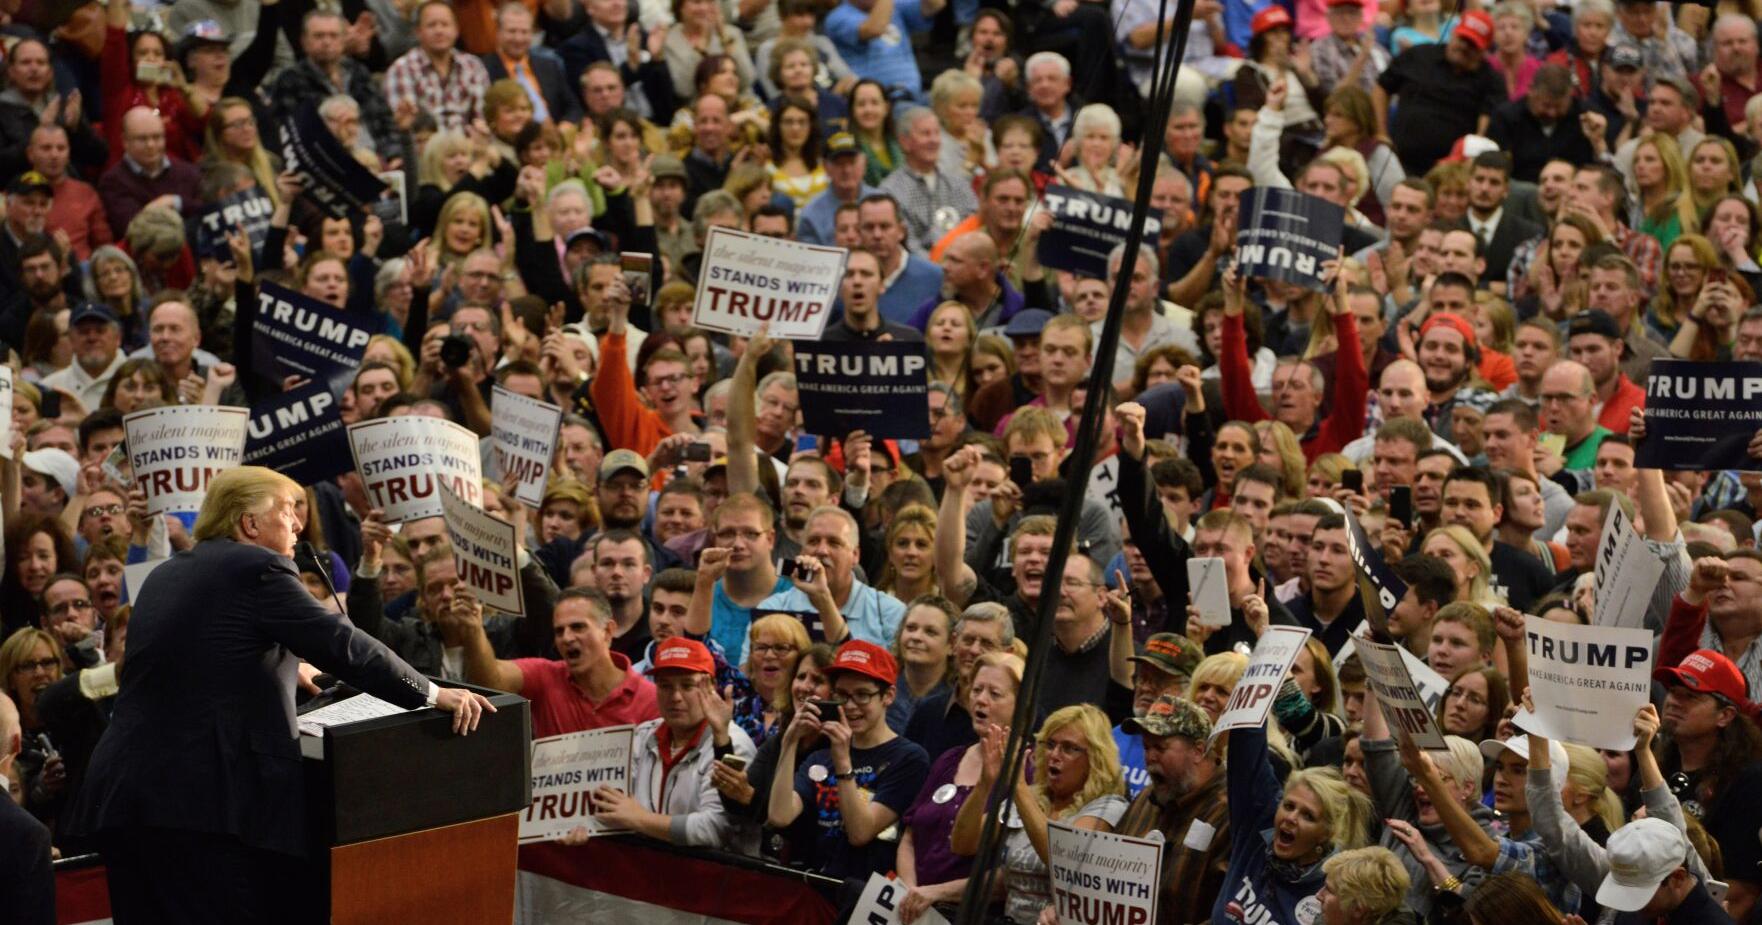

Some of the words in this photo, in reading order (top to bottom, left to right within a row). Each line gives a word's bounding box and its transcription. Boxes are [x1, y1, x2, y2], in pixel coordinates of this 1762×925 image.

[1045, 193, 1161, 236] TRUMP
[710, 266, 781, 291] STANDS
[787, 279, 830, 295] WITH
[707, 286, 822, 323] TRUMP
[258, 291, 370, 349] TRUMP
[270, 327, 303, 348] AMERICA
[303, 341, 332, 358] GREAT
[795, 352, 925, 377] TRUMP
[820, 383, 858, 394] AMERICA
[860, 385, 889, 394] GREAT
[1647, 375, 1762, 400] TRUMP
[1656, 408, 1690, 419] AMERICA
[1693, 410, 1726, 420] GREAT
[131, 429, 147, 447] the
[151, 424, 188, 440] silent
[277, 431, 308, 451] GREAT
[308, 421, 342, 439] AGAIN!
[359, 436, 380, 455] the
[381, 431, 419, 451] silent
[522, 436, 549, 456] WITH
[134, 445, 200, 468] STANDS
[205, 445, 240, 461] WITH
[362, 453, 433, 477] STANDS
[439, 454, 476, 477] WITH
[463, 520, 509, 553] majority
[472, 542, 511, 569] WITH
[1594, 509, 1622, 606] UMP
[1528, 631, 1649, 669] TRUMP
[1247, 663, 1283, 678] WITH
[1543, 672, 1574, 685] AMERICA
[1577, 677, 1607, 689] GREAT
[1609, 681, 1647, 693] AGAIN!
[1389, 686, 1417, 700] WITH
[532, 770, 582, 789] STANDS
[587, 766, 625, 783] WITH
[1051, 838, 1066, 857] the
[1066, 844, 1094, 865] silent
[1095, 854, 1152, 876] majority
[1053, 864, 1102, 890] STANDS
[1106, 878, 1150, 900] WITH
[1055, 887, 1148, 925] TRUMP
